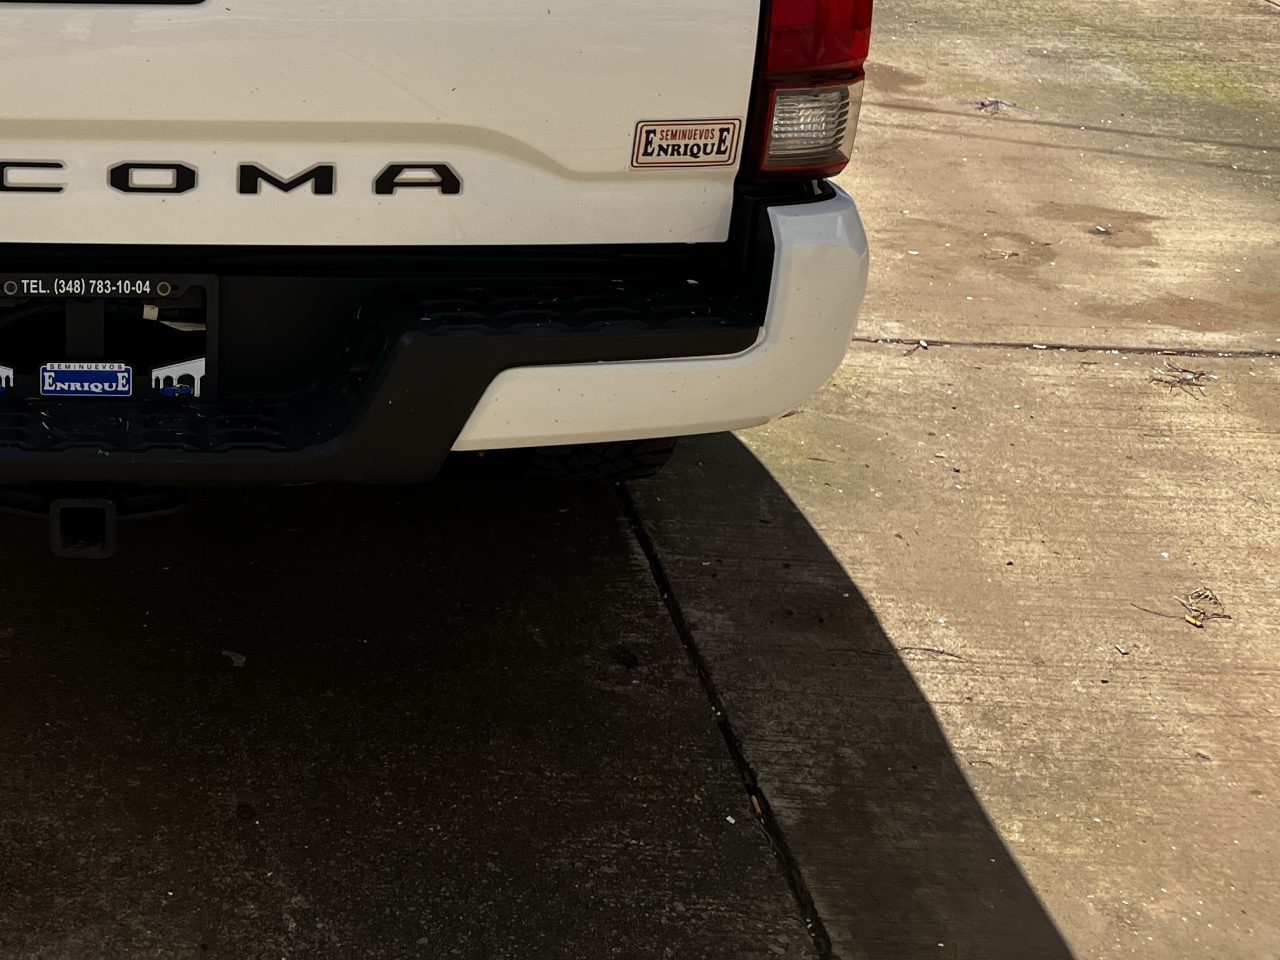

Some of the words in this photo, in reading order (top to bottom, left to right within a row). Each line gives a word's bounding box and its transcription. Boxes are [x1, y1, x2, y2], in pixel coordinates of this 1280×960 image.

[642, 127, 730, 158] ENRIQUE
[659, 128, 715, 141] SEMINUEVOS
[21, 279, 50, 294] TEL.
[54, 278, 86, 295] (348)
[89, 279, 151, 294] 783-10-04
[43, 371, 129, 393] ENRIQUE
